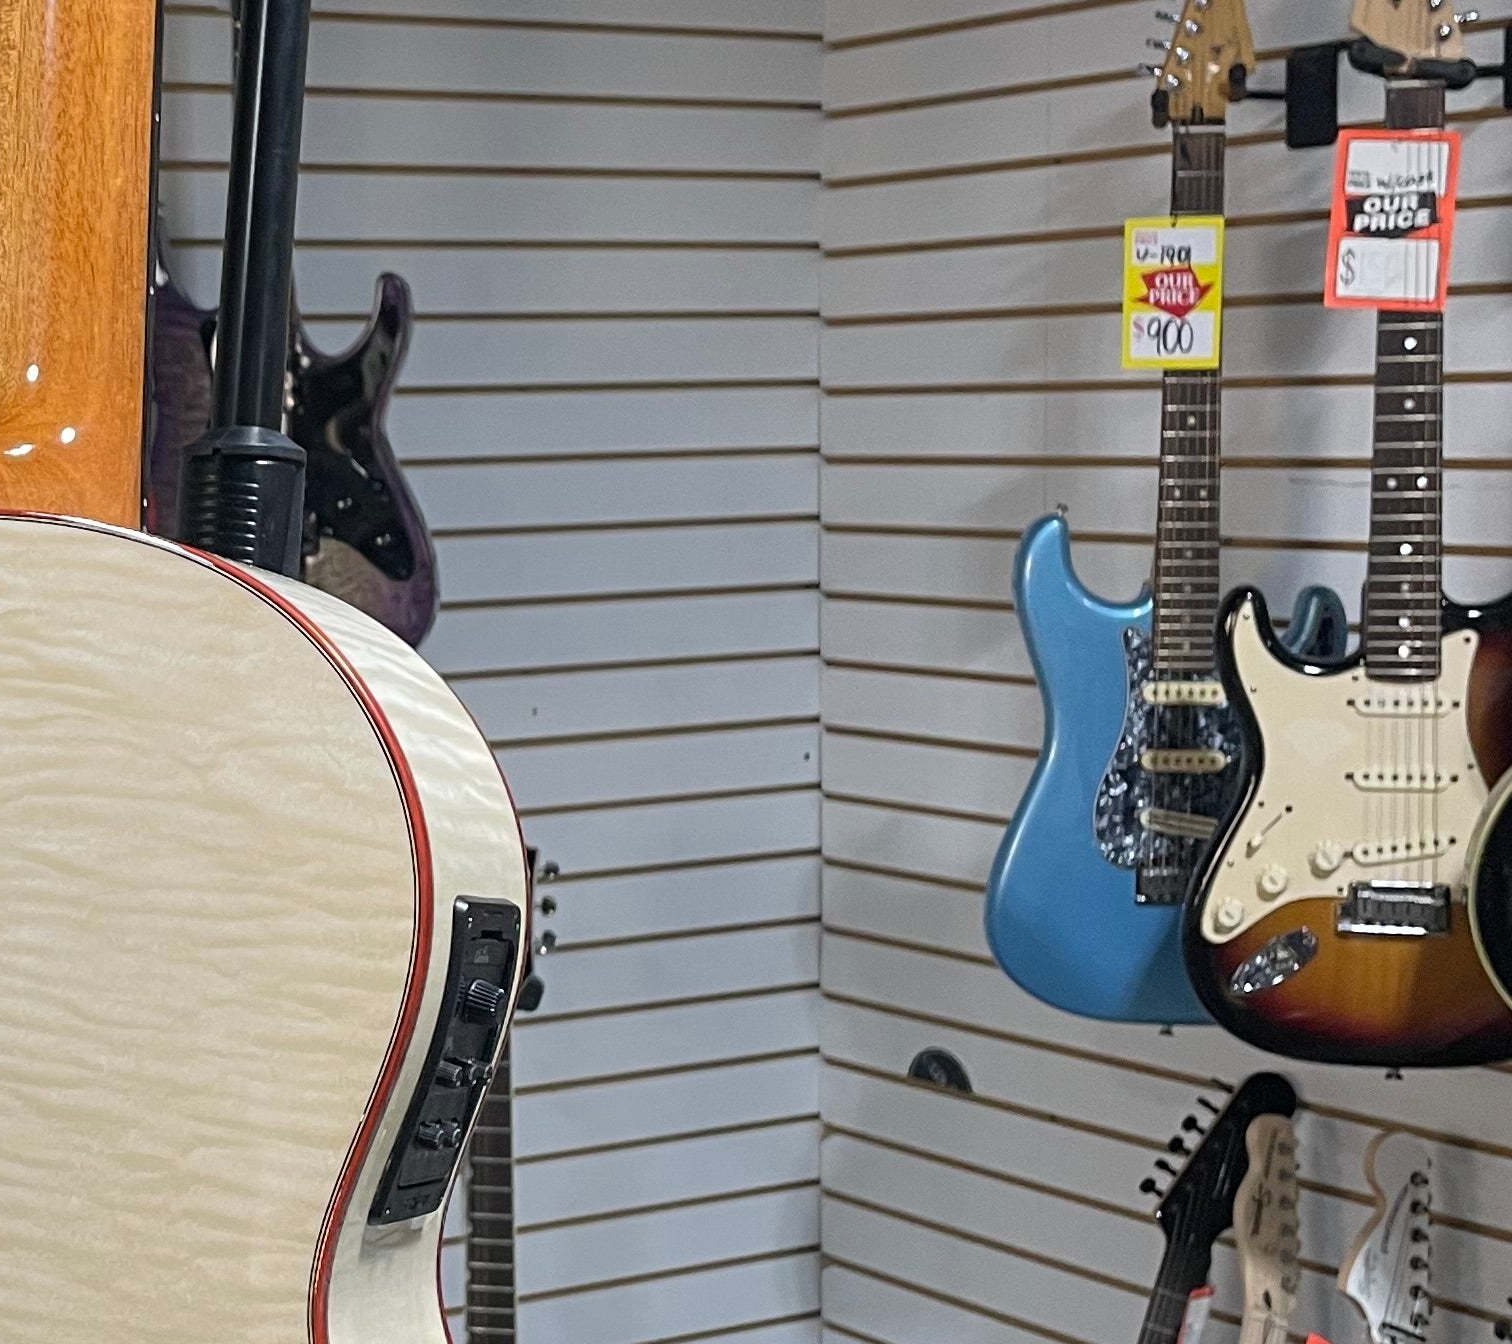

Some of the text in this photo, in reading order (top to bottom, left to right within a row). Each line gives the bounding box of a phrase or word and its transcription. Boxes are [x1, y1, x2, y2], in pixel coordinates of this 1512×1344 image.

[1363, 194, 1418, 213] OUR
[1353, 208, 1432, 233] PRICE
[1339, 248, 1356, 286] $
[1155, 272, 1193, 289] OUR
[1149, 286, 1199, 306] PRICE
